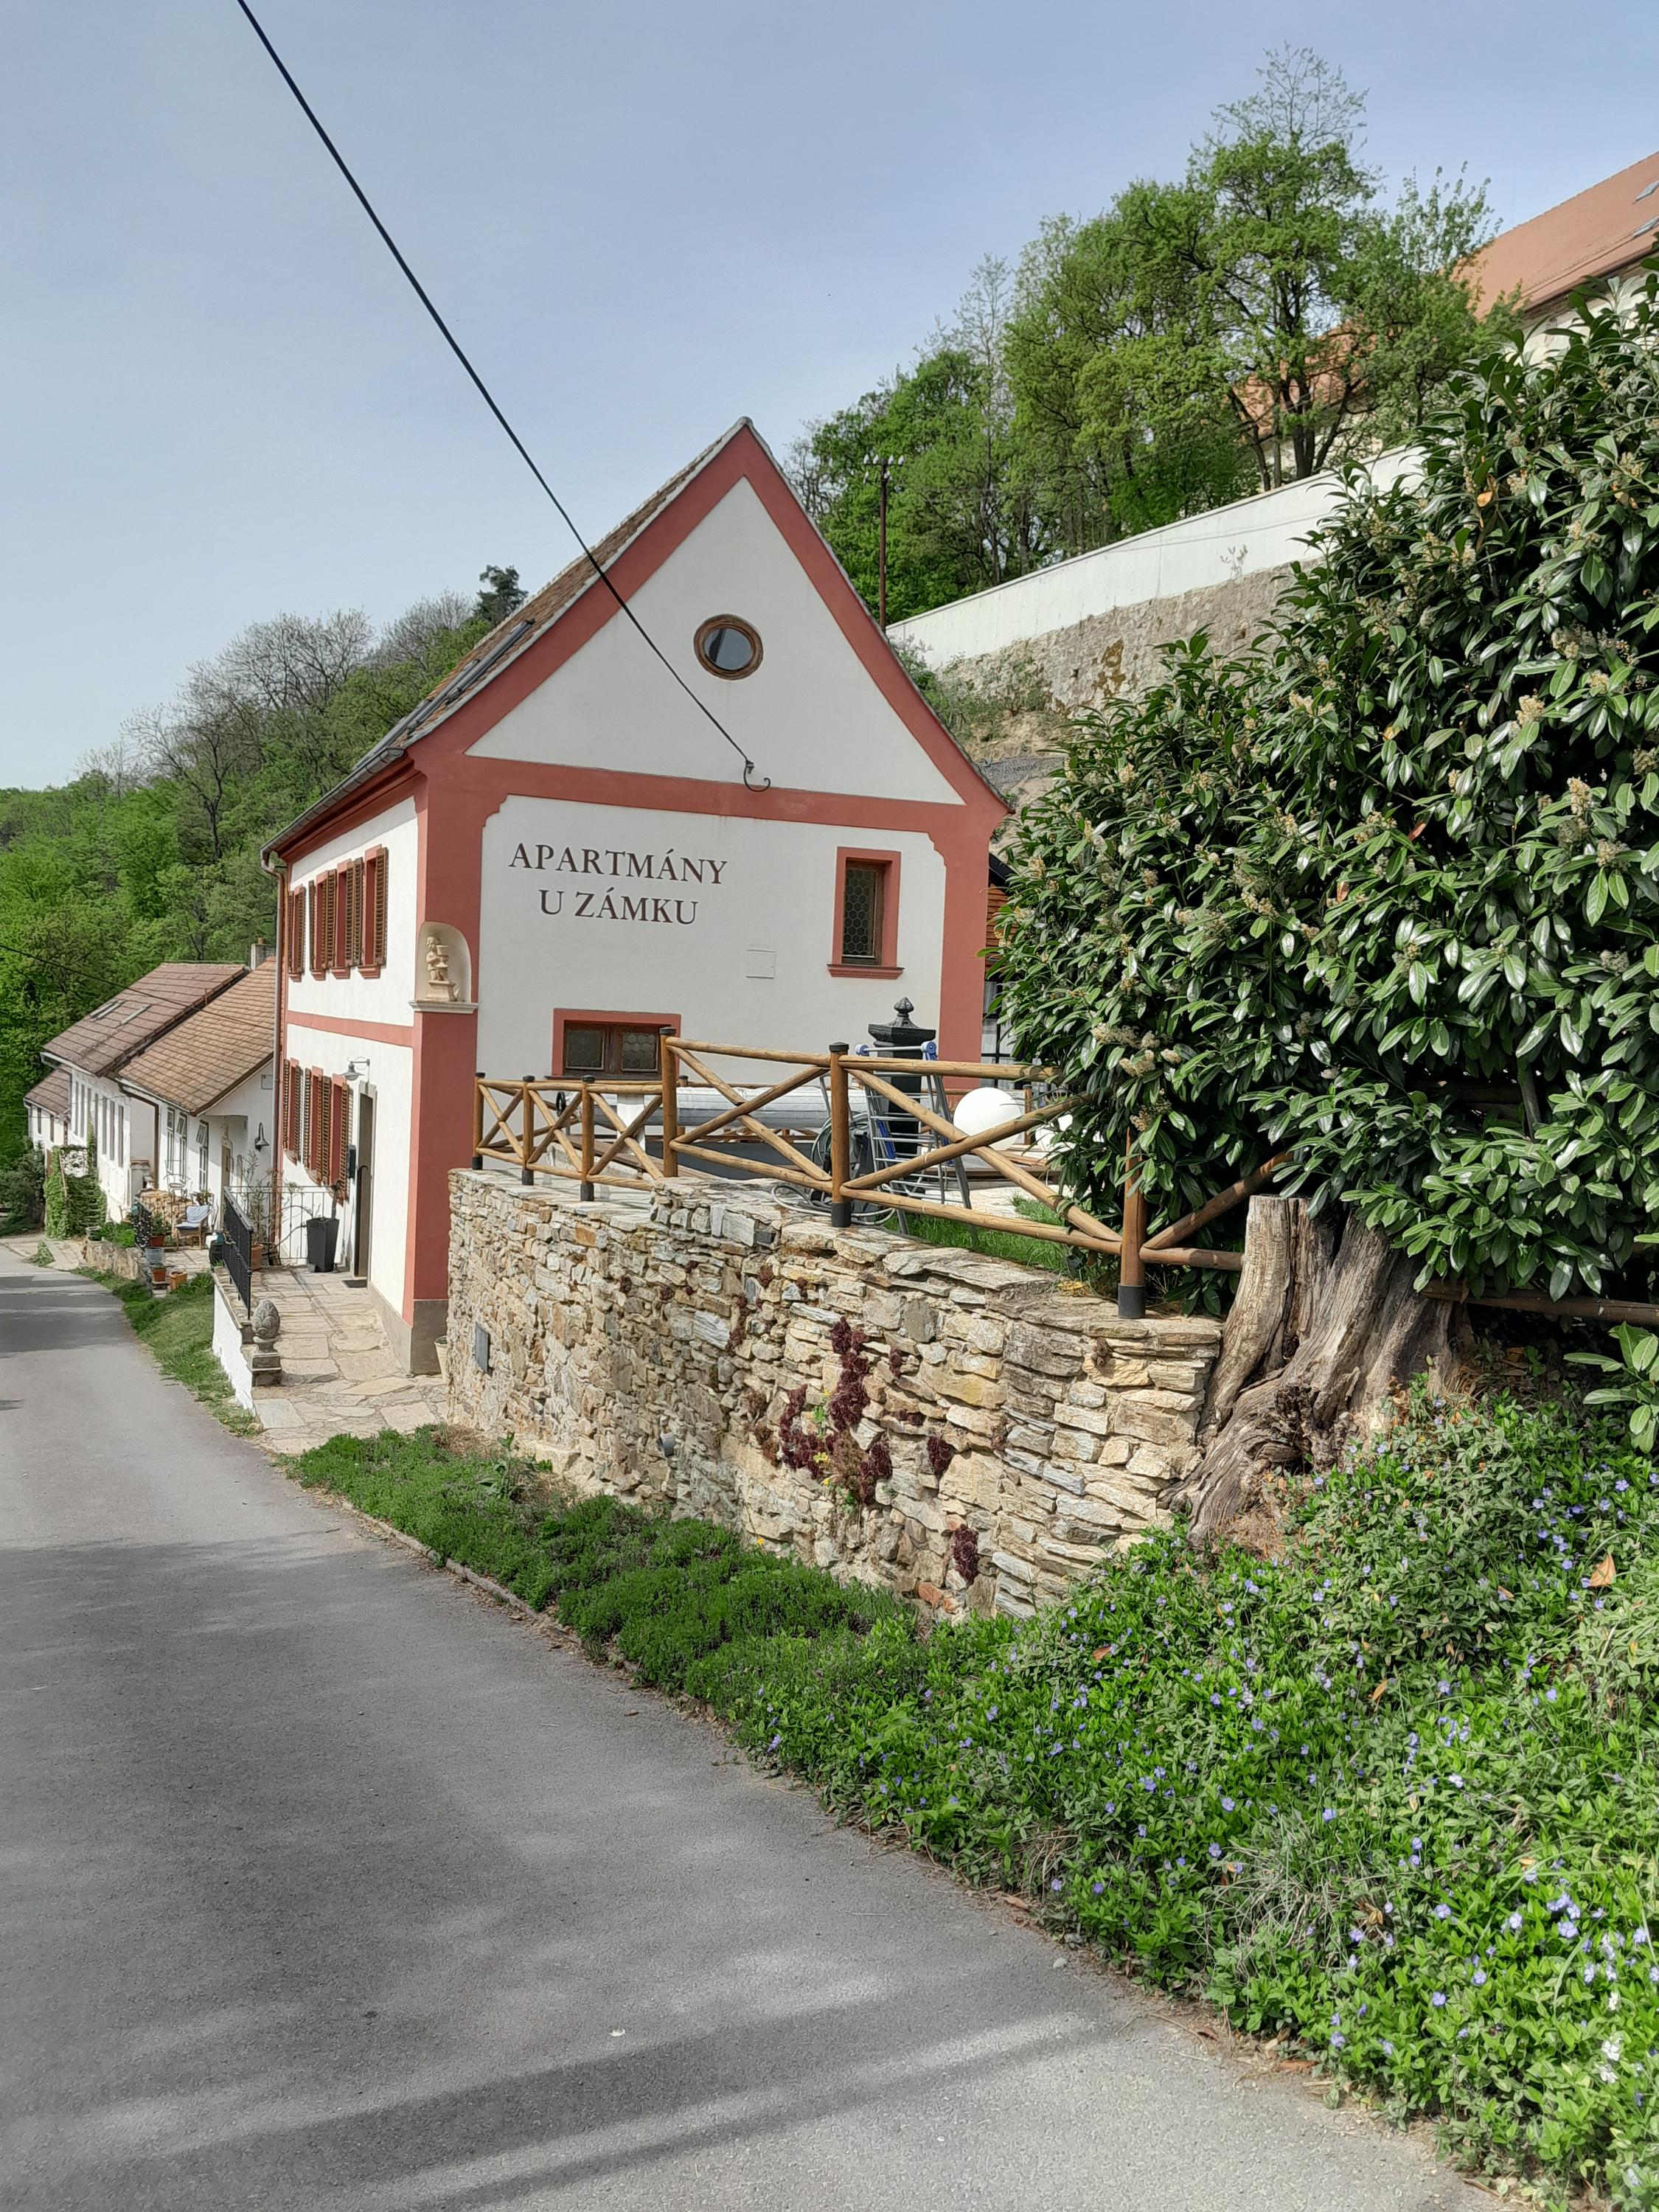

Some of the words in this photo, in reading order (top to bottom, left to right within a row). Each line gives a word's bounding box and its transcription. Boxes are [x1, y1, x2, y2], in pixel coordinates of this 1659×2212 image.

[508, 843, 728, 885] APARTMÁNY
[538, 889, 565, 915] U
[574, 886, 700, 925] ZÁMKU
